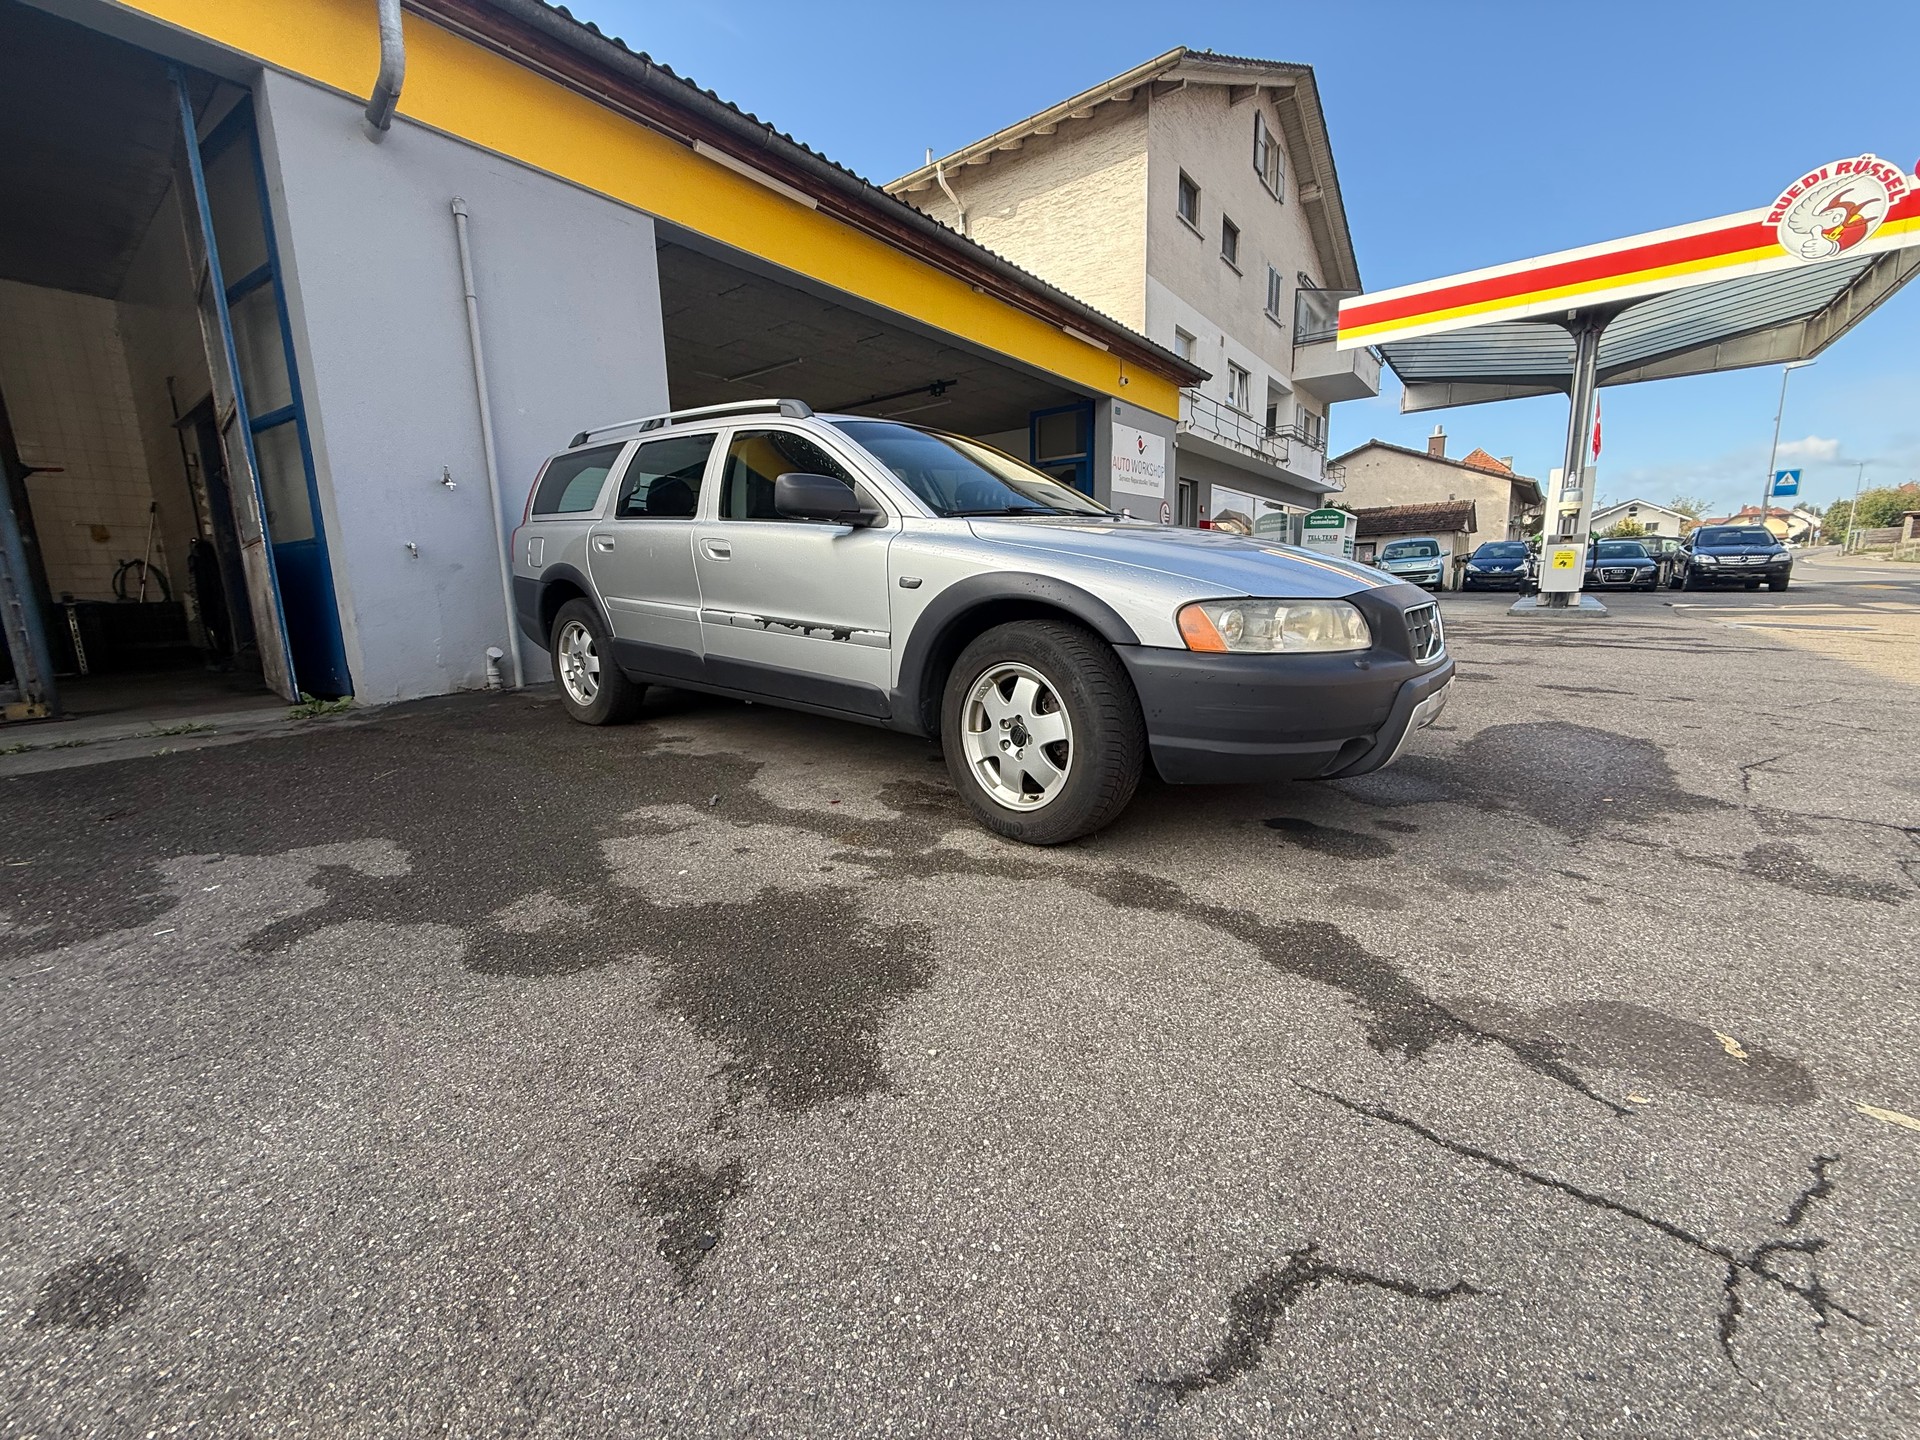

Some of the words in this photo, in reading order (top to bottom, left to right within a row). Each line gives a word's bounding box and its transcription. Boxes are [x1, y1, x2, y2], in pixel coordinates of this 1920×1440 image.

[1766, 168, 1828, 223] RUEDI
[1835, 156, 1906, 202] RÜSSEL
[1113, 456, 1130, 472] AUTO
[1131, 459, 1165, 479] WORKSHOP
